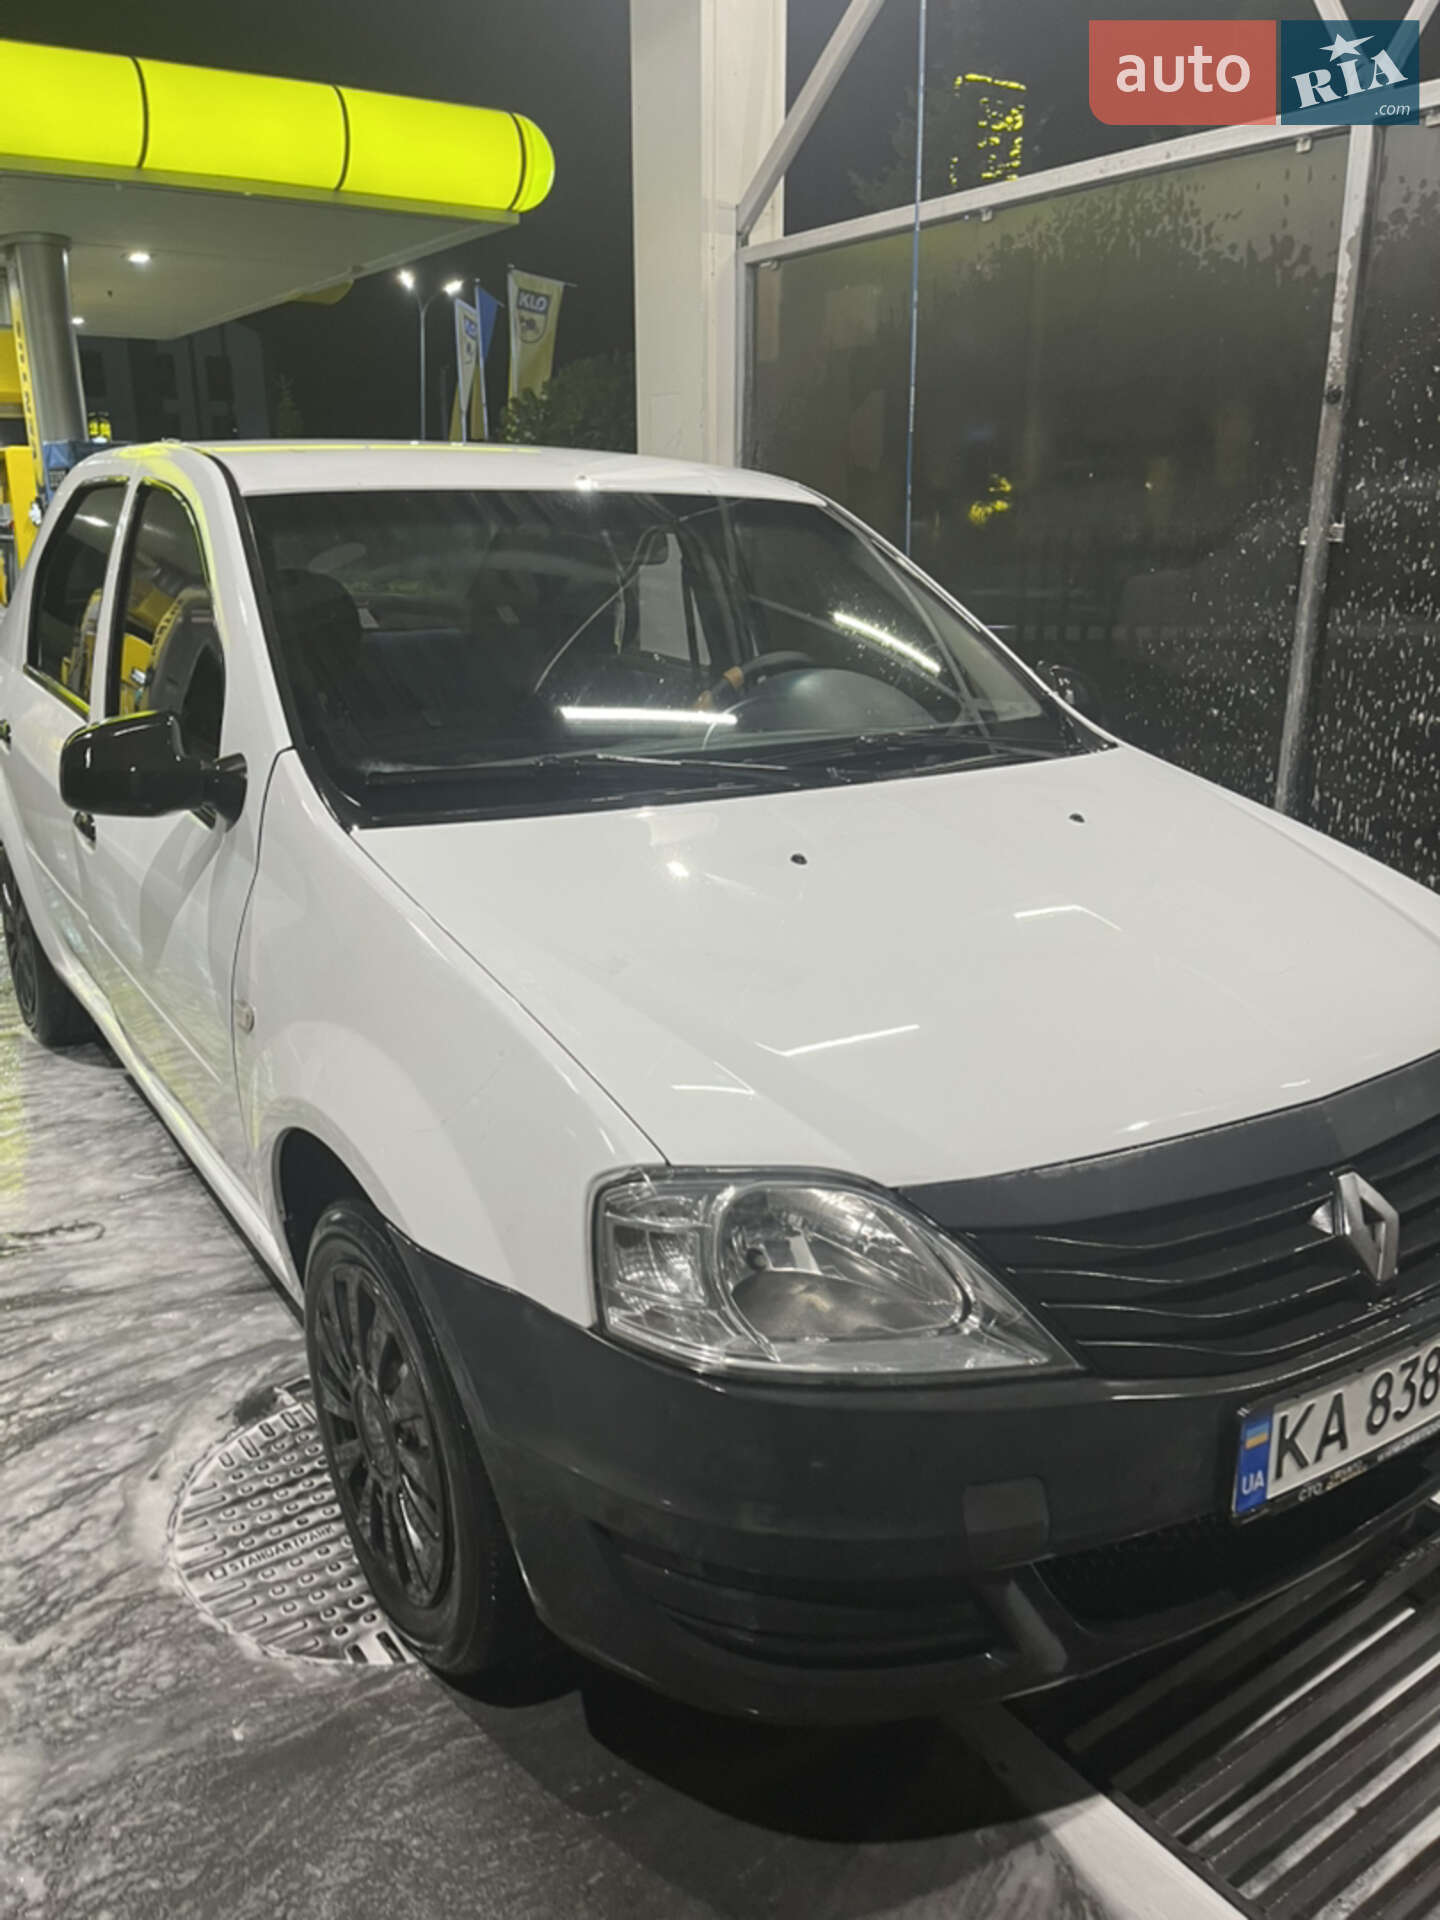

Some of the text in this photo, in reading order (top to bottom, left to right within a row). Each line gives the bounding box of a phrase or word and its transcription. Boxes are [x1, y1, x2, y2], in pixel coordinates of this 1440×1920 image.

[519, 291, 548, 312] KLO
[1275, 1392, 1348, 1480] KA
[1242, 1470, 1265, 1494] UA
